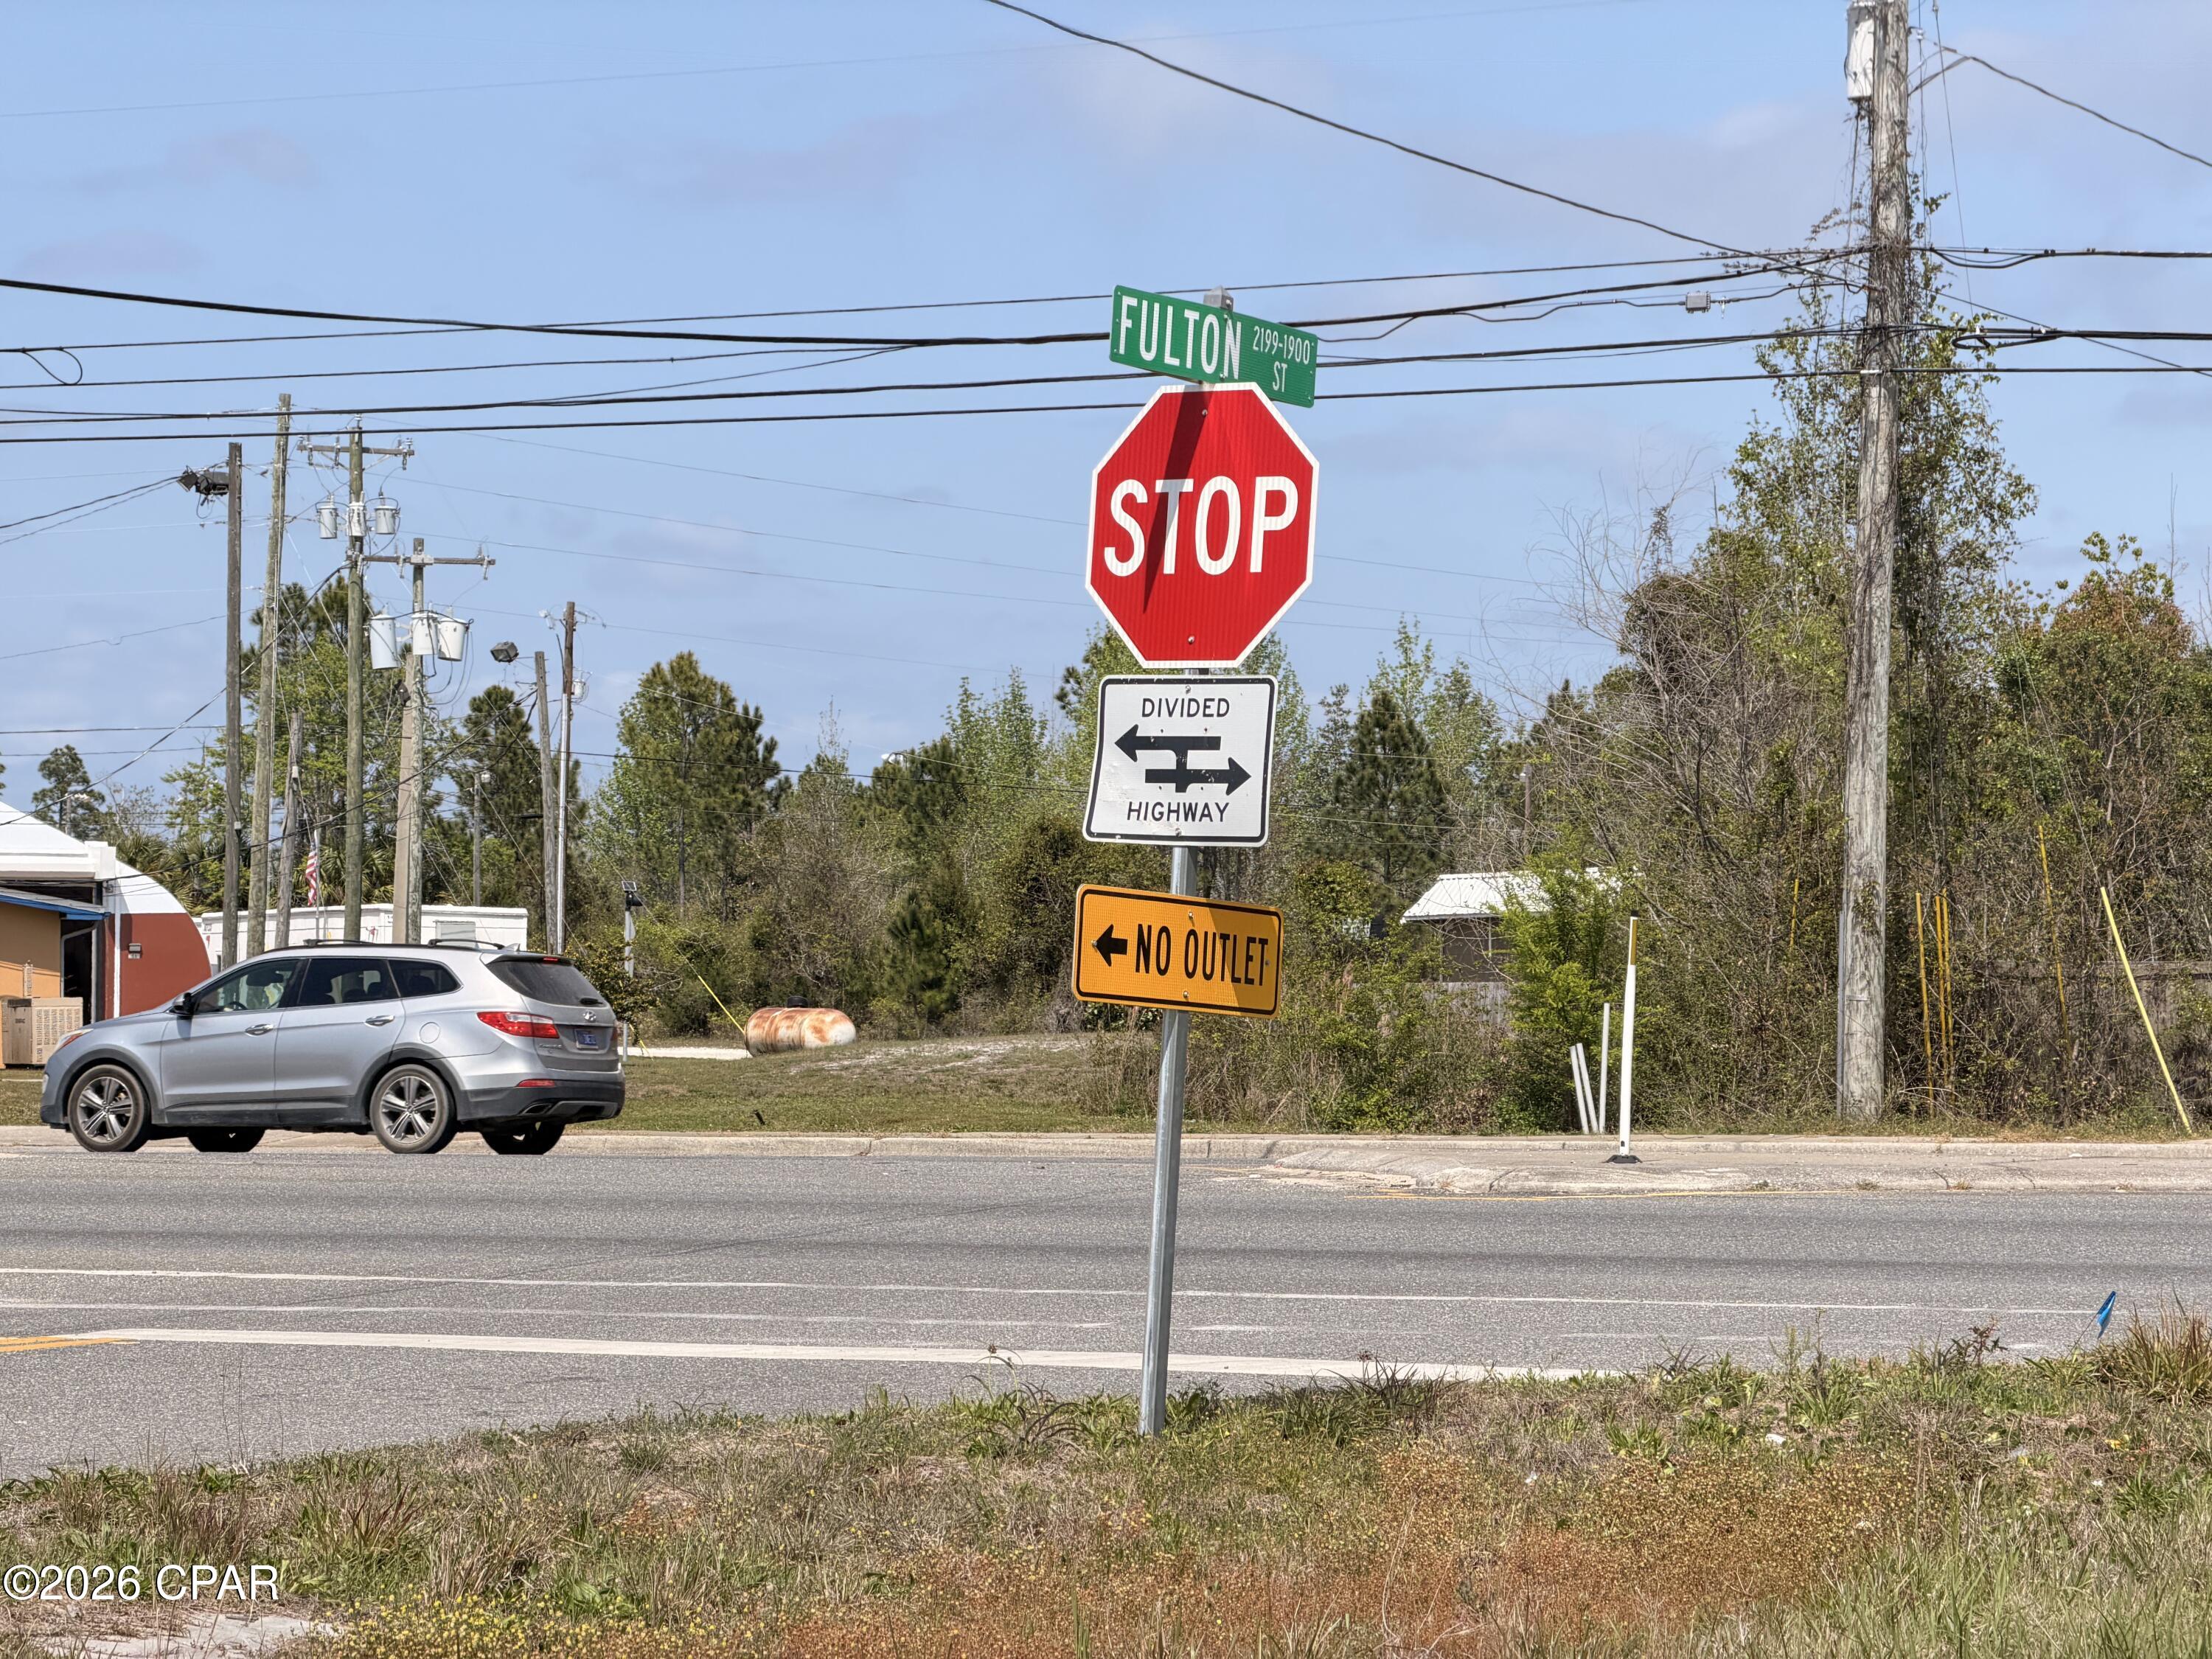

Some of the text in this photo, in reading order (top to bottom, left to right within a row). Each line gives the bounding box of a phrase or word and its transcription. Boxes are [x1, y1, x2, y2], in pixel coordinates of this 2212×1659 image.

[1119, 295, 1242, 380] FULTON
[1253, 325, 1310, 365] 2199-1900
[1272, 361, 1288, 392] ST
[1104, 476, 1298, 577] STOP
[1141, 698, 1230, 718] DIVIDED
[1127, 801, 1230, 822] HIGHWAY
[1135, 923, 1269, 987] NO OUTLET
